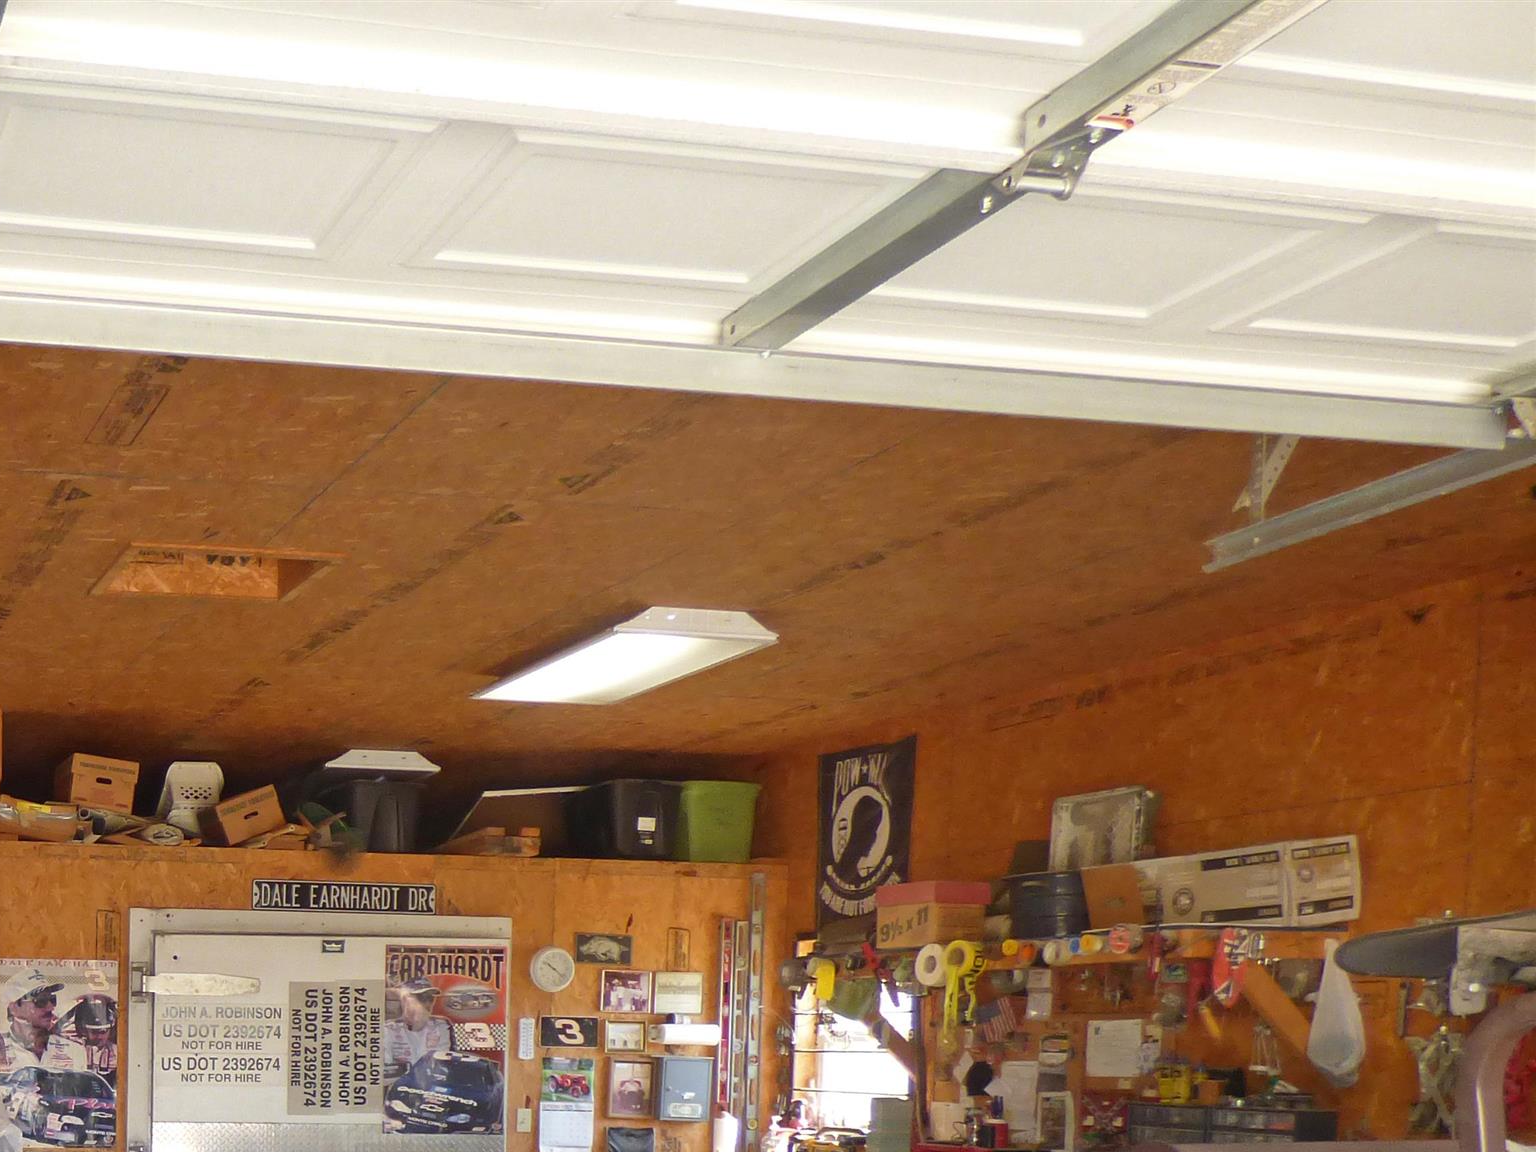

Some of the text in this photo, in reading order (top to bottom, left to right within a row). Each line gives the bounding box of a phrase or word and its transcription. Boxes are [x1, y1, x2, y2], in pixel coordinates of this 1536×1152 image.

[832, 757, 862, 817] POW
[261, 883, 428, 912] DALE EARNHARDT DR
[85, 969, 111, 991] 3
[388, 954, 504, 989] EARNHARDT
[162, 1006, 282, 1020] JOHN A. ROBINSON
[163, 1024, 282, 1040] US DOT 2392674
[181, 1040, 262, 1051] NOT FOR HIRE
[338, 986, 351, 1106] JOHN A. ROBINSON
[370, 1007, 381, 1085] NOT FOR HIRE
[464, 1022, 496, 1048] 3
[554, 1018, 585, 1045] 3
[291, 1008, 302, 1087] NOT FOR HIRE
[303, 989, 318, 1107] US DOT 2392674
[320, 989, 333, 1108] JOHN A. ROBINSON
[354, 987, 368, 1106] US DOT 2392674
[161, 1057, 281, 1072] US DOT 2392674
[181, 1073, 262, 1083] NOT FOR HIRE
